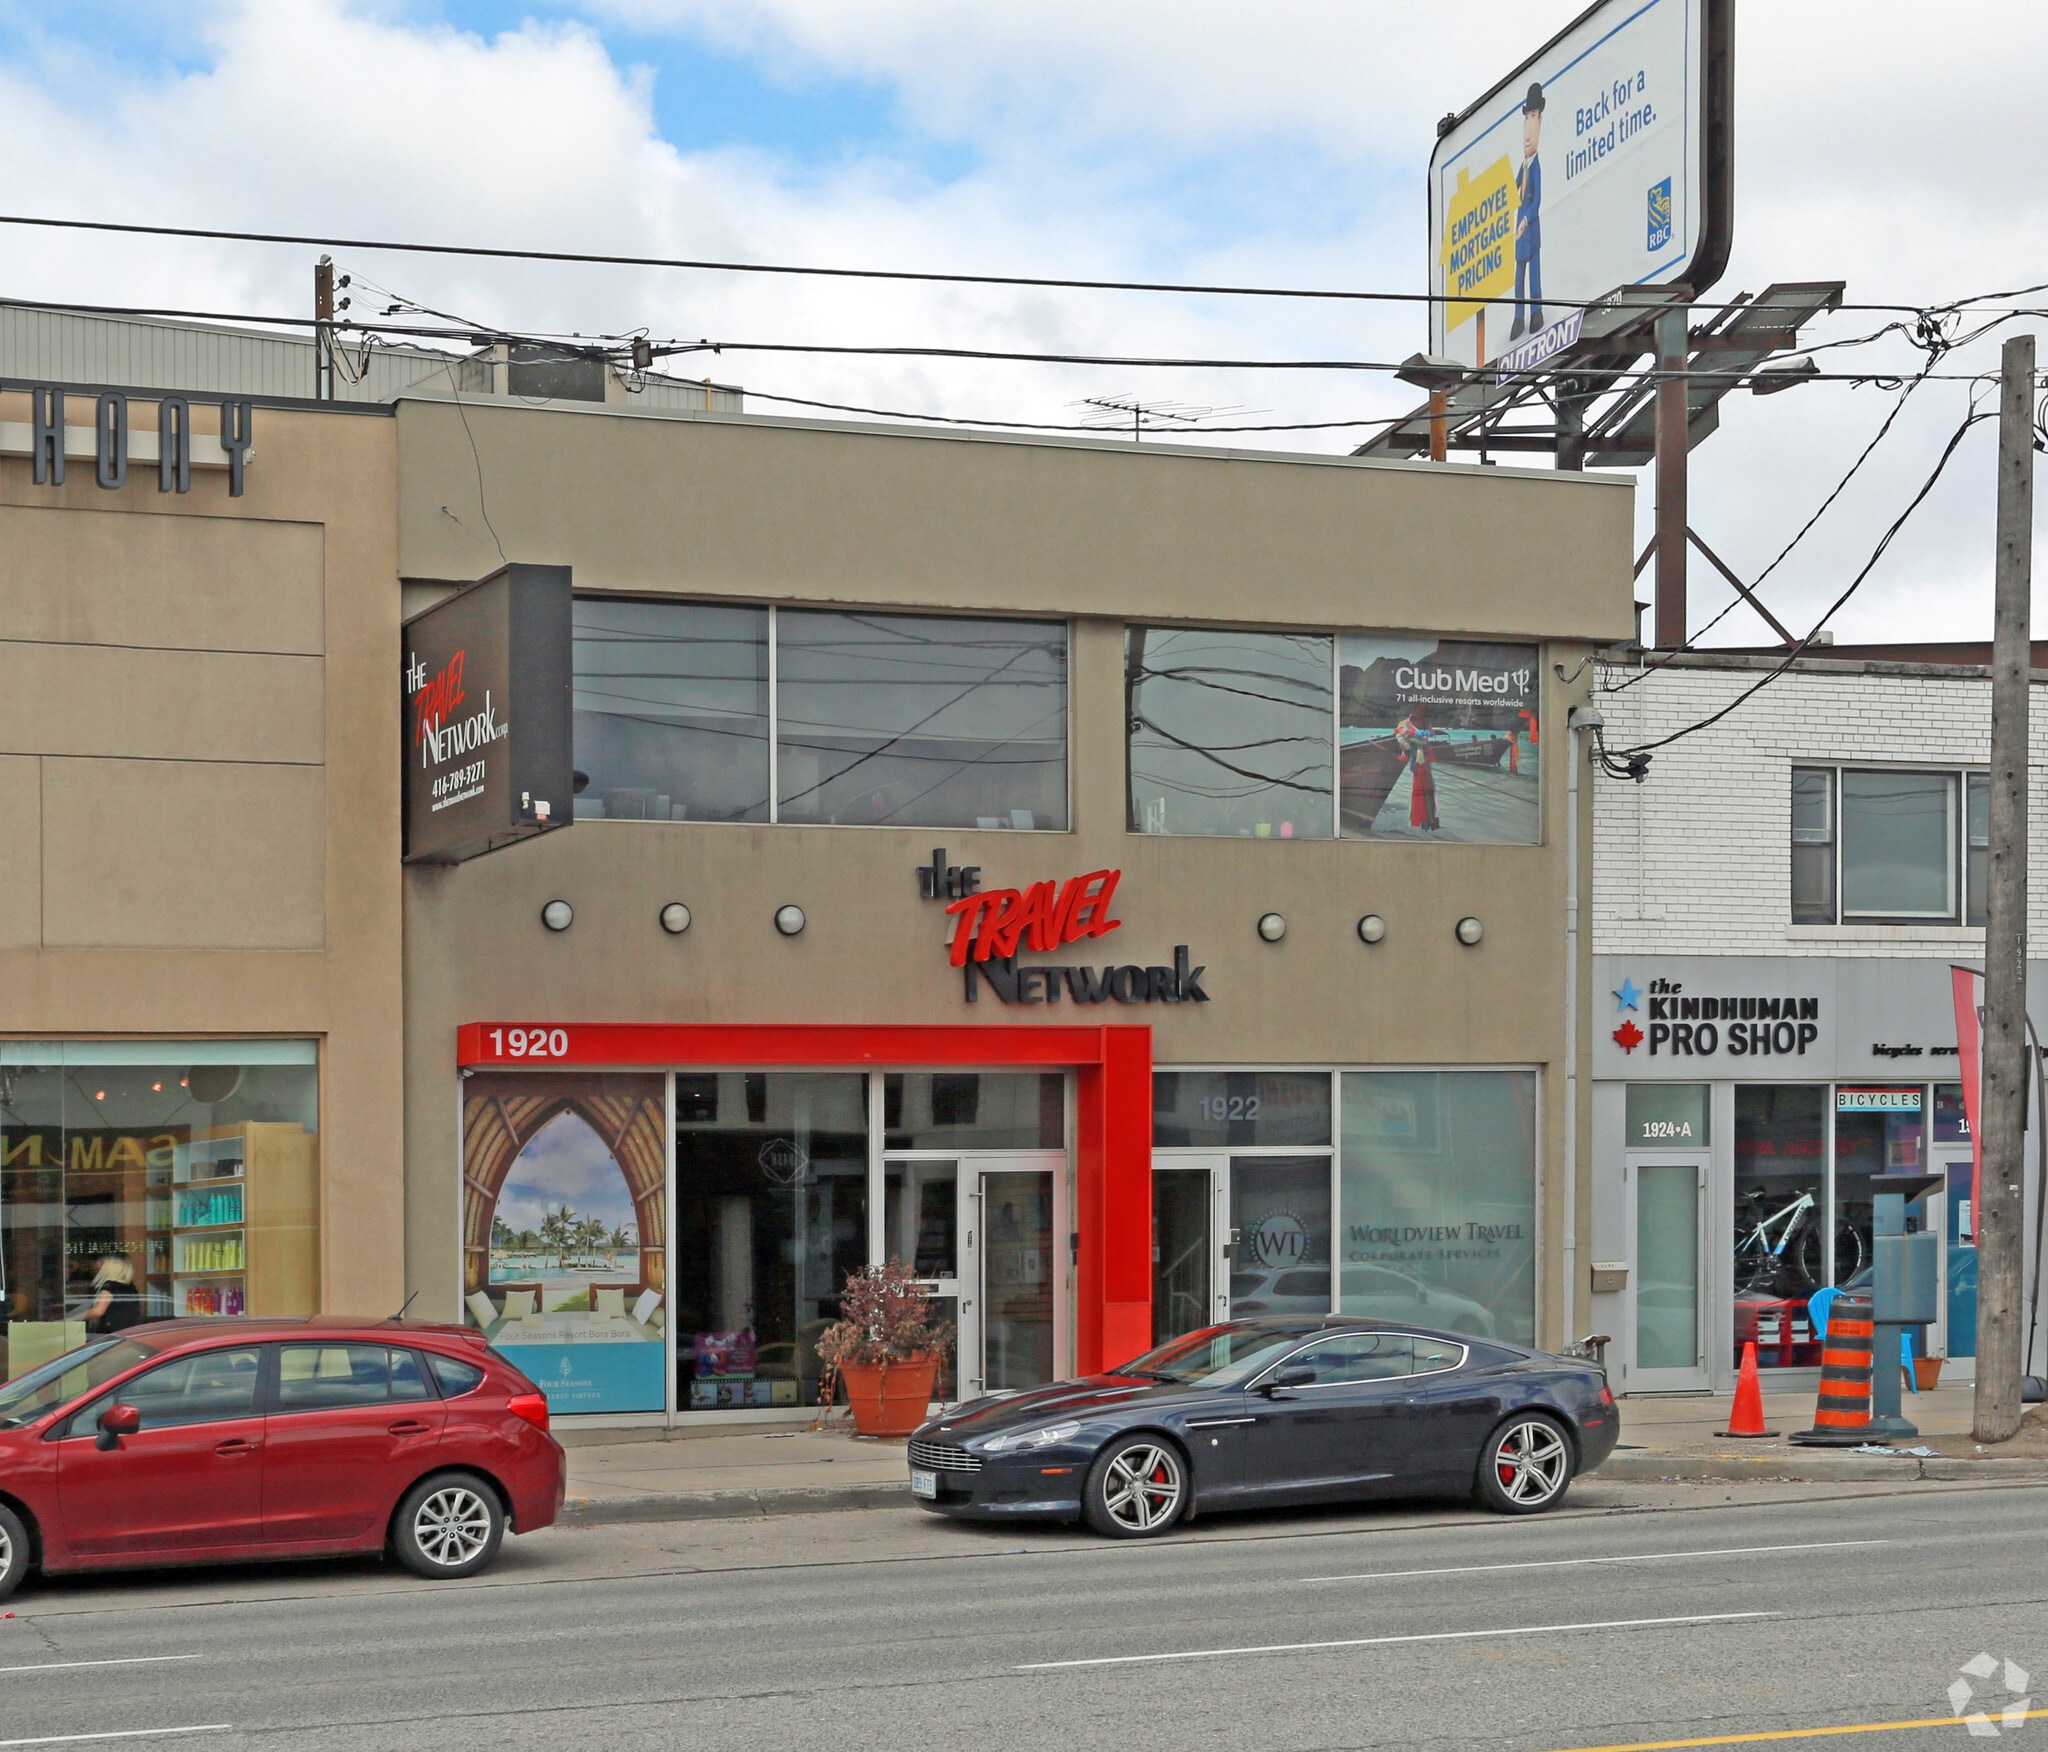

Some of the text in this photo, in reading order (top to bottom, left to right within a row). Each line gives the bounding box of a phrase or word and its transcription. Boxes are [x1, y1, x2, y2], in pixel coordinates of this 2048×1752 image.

[1576, 70, 1645, 137] Back for a
[1566, 104, 1657, 180] limited time.
[1451, 184, 1508, 247] EMPLOYEE
[1450, 210, 1510, 275] MORTGAGE
[1649, 224, 1670, 249] RBC
[1458, 245, 1502, 297] PRICING
[1499, 313, 1580, 381] OUTFRONT
[1395, 666, 1509, 694] Club Med
[414, 649, 467, 747] TRAVEL
[1396, 693, 1524, 708] 71 all-inclusive resorts worldwide
[431, 759, 486, 798] 416-789-3271
[945, 868, 1122, 967] TRAVEL
[1649, 978, 1682, 995] the
[1649, 997, 1819, 1020] KINDHUMAN
[489, 1028, 569, 1058] 1920
[1649, 1021, 1818, 1056] PRO SHOP
[1872, 1043, 1924, 1059] bicycles
[1200, 1095, 1262, 1122] 1922
[1838, 1094, 1920, 1107] BICYCLES
[1259, 1231, 1300, 1256] WT
[1350, 1222, 1525, 1246] WORLDVIEW TRAVEL
[1350, 1248, 1501, 1263] CORPORATE SERVICES
[500, 1329, 631, 1340] Four Seasons Resort Bora Bora
